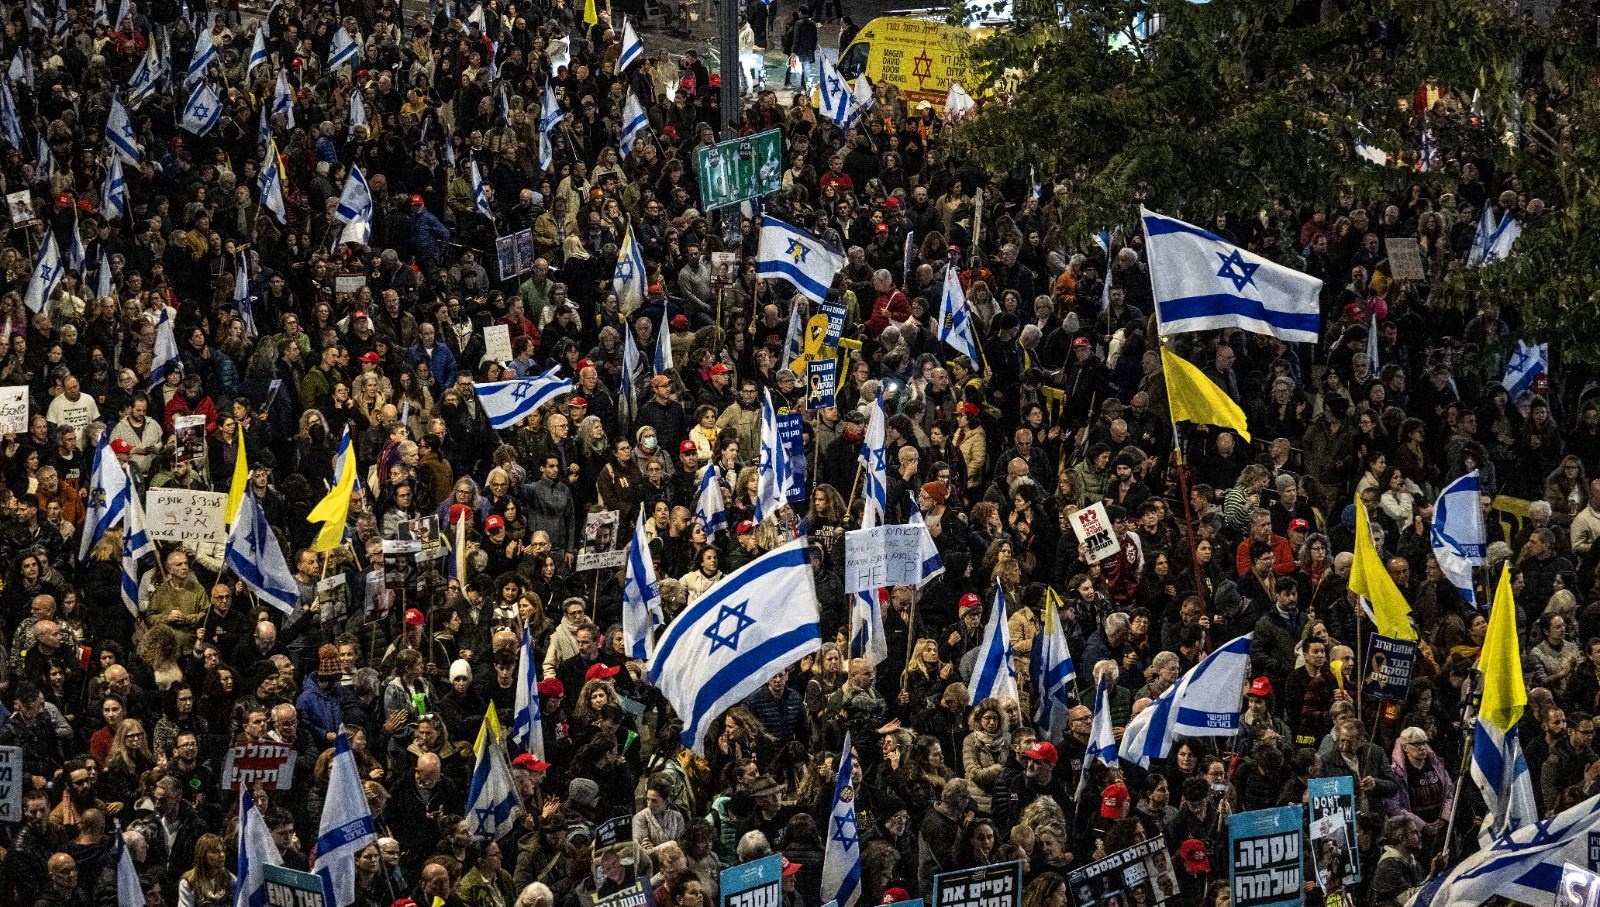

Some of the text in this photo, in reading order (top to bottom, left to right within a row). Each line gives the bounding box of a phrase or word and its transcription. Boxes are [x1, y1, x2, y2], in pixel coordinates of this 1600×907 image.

[883, 48, 904, 59] MAGEN
[882, 57, 900, 66] DAVID
[881, 65, 900, 74] ADOM
[888, 73, 907, 83] ISRAEL
[828, 323, 841, 331] עסק
[1078, 509, 1097, 525] לא
[1084, 529, 1111, 548] את
[858, 561, 917, 587] HELP
[1374, 638, 1414, 655] אנחנו הרוב
[1380, 664, 1410, 677] עסקת
[1390, 657, 1411, 669] בעד
[1370, 671, 1408, 686] חטופים
[1206, 713, 1231, 722] חופשי
[1206, 720, 1231, 728] בארצנו
[1313, 795, 1341, 810] DONT
[1149, 837, 1166, 853] את
[1234, 832, 1299, 870] עסקה.
[941, 875, 1014, 904] לסיים את
[1235, 867, 1300, 904] שלמה!
[266, 881, 323, 907] END THE
